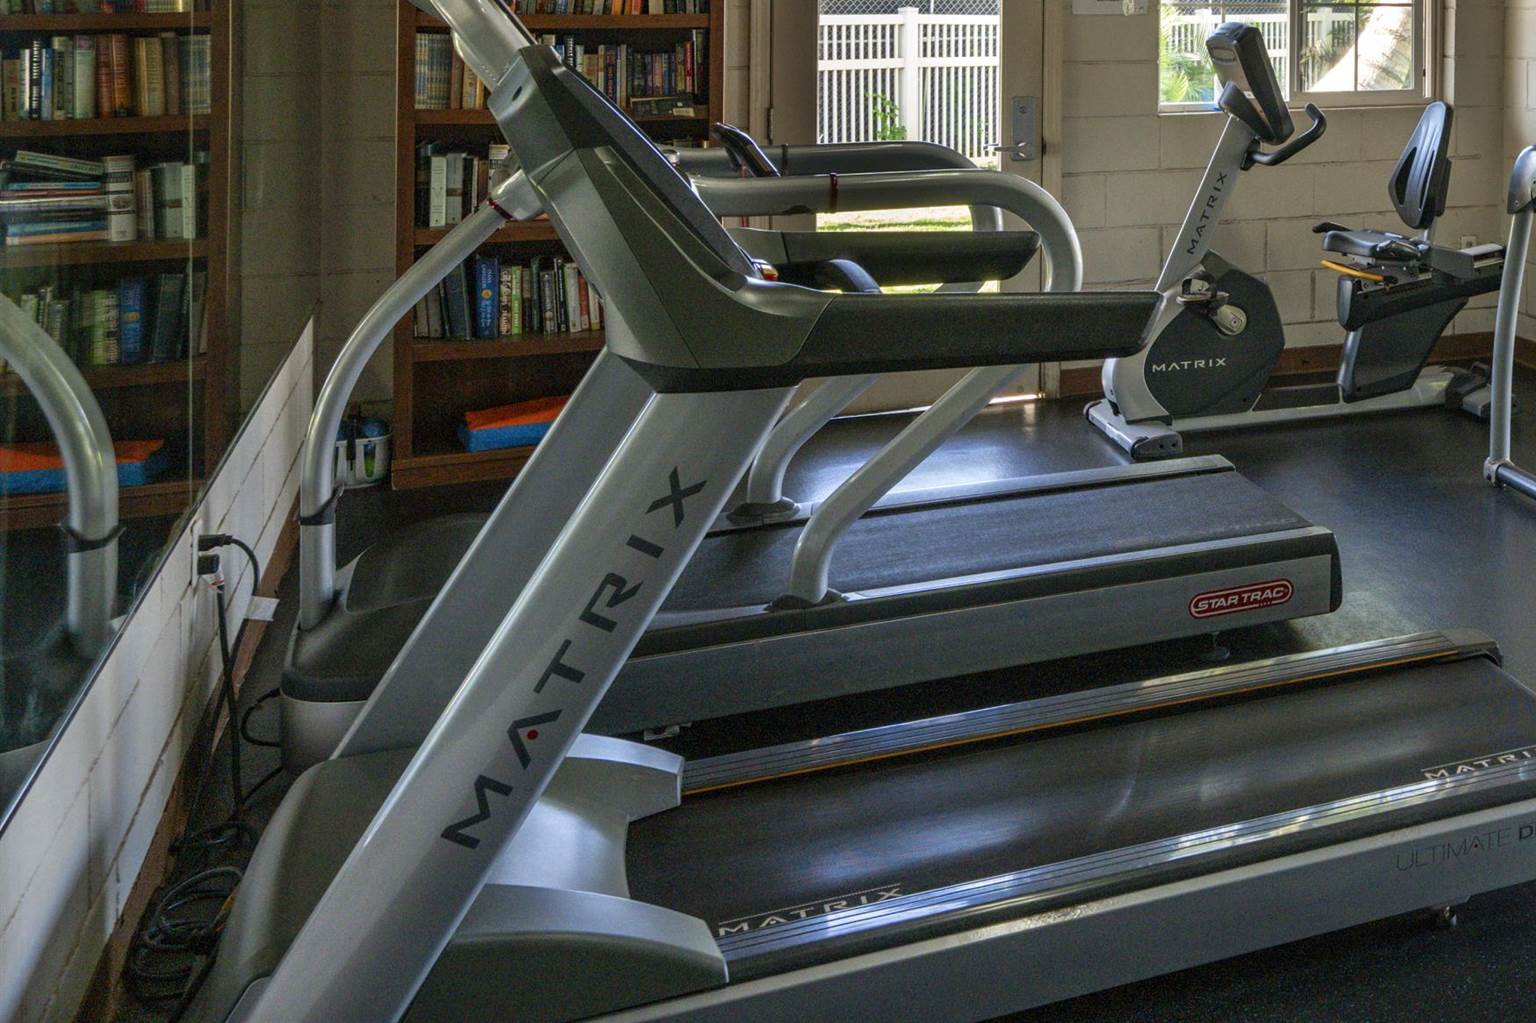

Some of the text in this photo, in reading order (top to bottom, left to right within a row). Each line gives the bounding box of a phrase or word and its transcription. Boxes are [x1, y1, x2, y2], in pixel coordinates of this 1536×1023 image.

[1187, 171, 1227, 256] MATRIX
[1152, 356, 1227, 374] MATRIX
[1197, 586, 1285, 611] STAR TRAC
[440, 465, 708, 850] MATRIX
[1395, 826, 1514, 873] ULTIMATE
[718, 887, 903, 937] MATRIX
